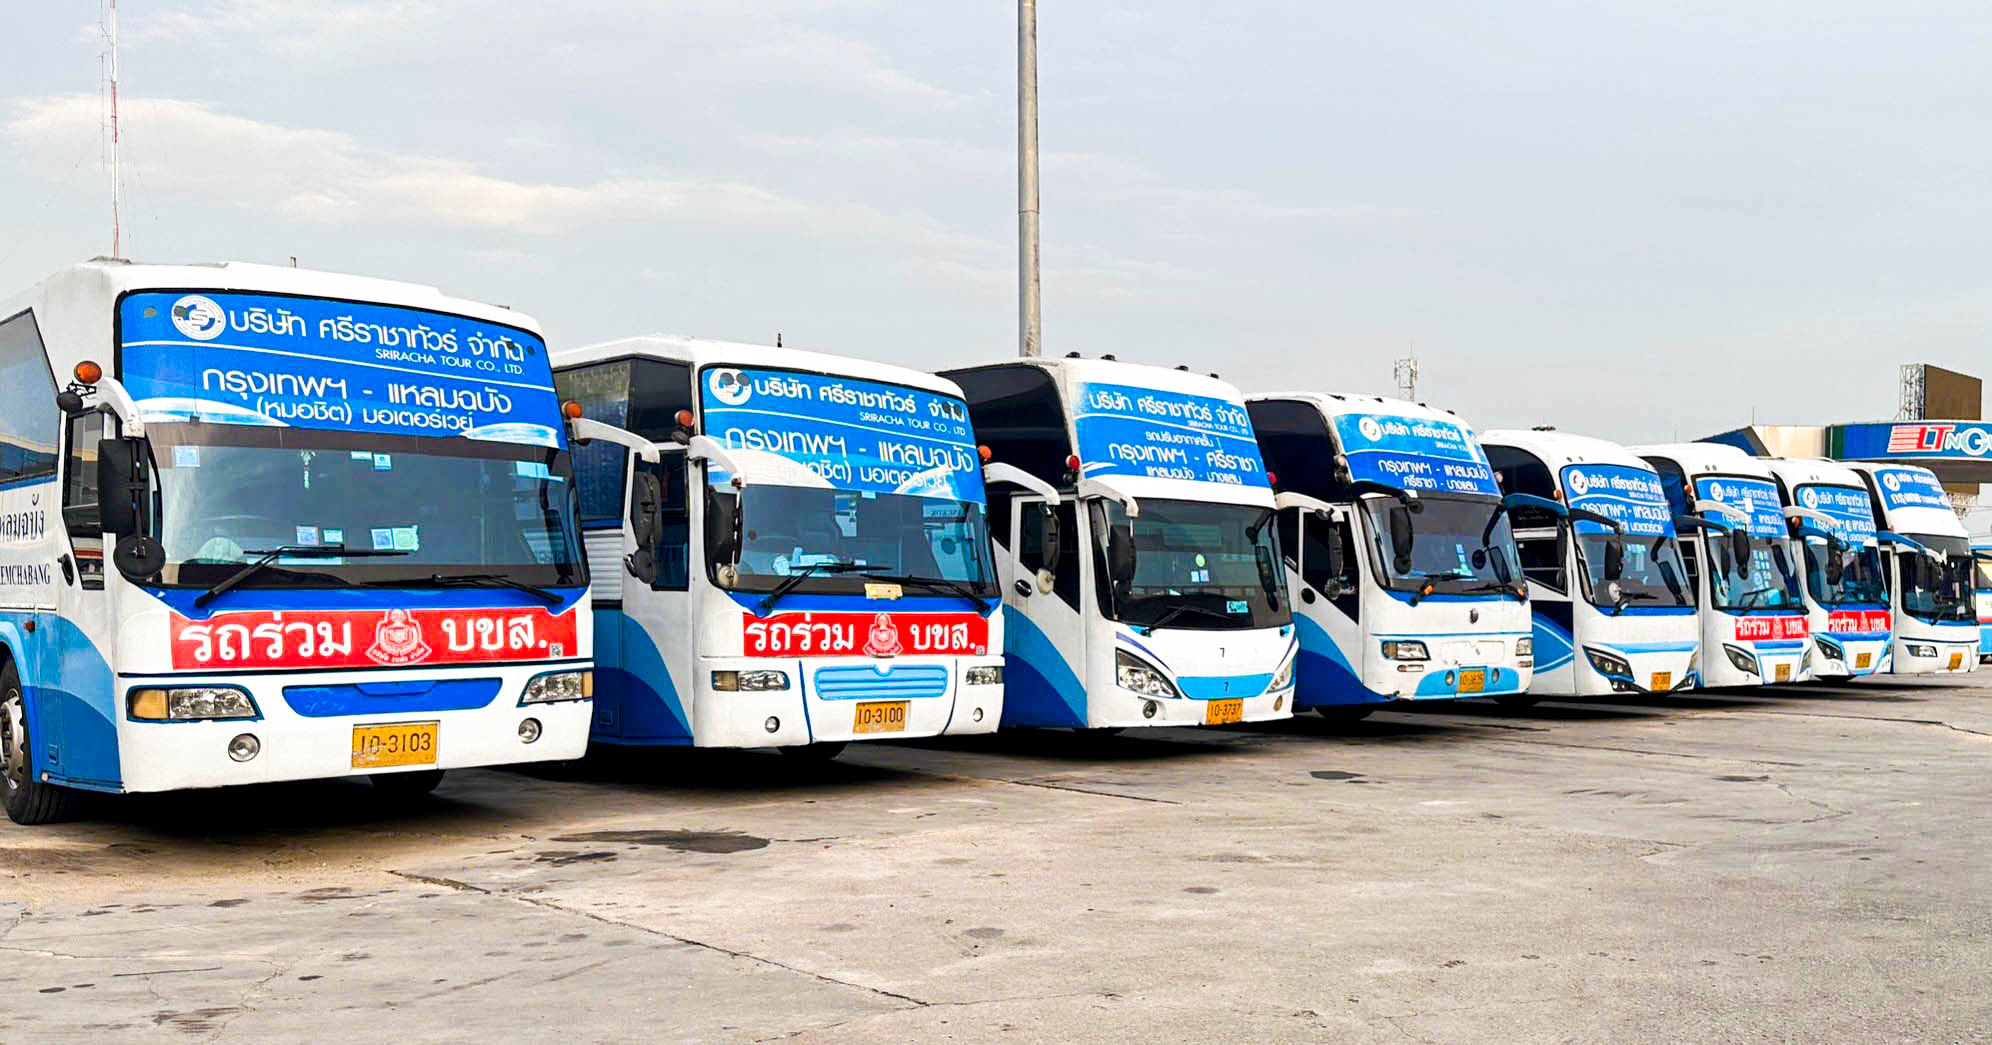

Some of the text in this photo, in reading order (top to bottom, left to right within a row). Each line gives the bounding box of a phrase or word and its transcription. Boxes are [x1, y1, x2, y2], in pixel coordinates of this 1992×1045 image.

[230, 308, 525, 362] บริษัท ศรีราชาทัวร์ จำกัด
[376, 348, 436, 365] SRIRACHA
[440, 356, 473, 369] TOUR
[203, 369, 347, 400] กรุงเทพฯ
[388, 383, 512, 414] แหลมฉบัง
[754, 377, 812, 400] บริษัท
[820, 384, 916, 414] ศรีราชาทัวร์
[257, 397, 474, 431] (หมอชิต) มอเตอร์เวย์
[860, 411, 904, 426] SRIRACHA
[908, 418, 931, 430] TOUR
[1089, 391, 1248, 428] บริษัท ศรีราชาทัวร์ จำกัด
[725, 428, 847, 457] กรงเทพฯ
[878, 441, 974, 472] แหลมฉบัง
[1109, 443, 1188, 466] กรุงเทพฯ
[1206, 449, 1258, 472] ศรีราชา
[1378, 459, 1432, 476] กรุงเทพฯ
[179, 611, 547, 662] รถร่วม บขส.
[745, 612, 976, 652] รถร่วม บขส.
[858, 706, 904, 725] 10-3100
[361, 732, 432, 754] 10-3103
